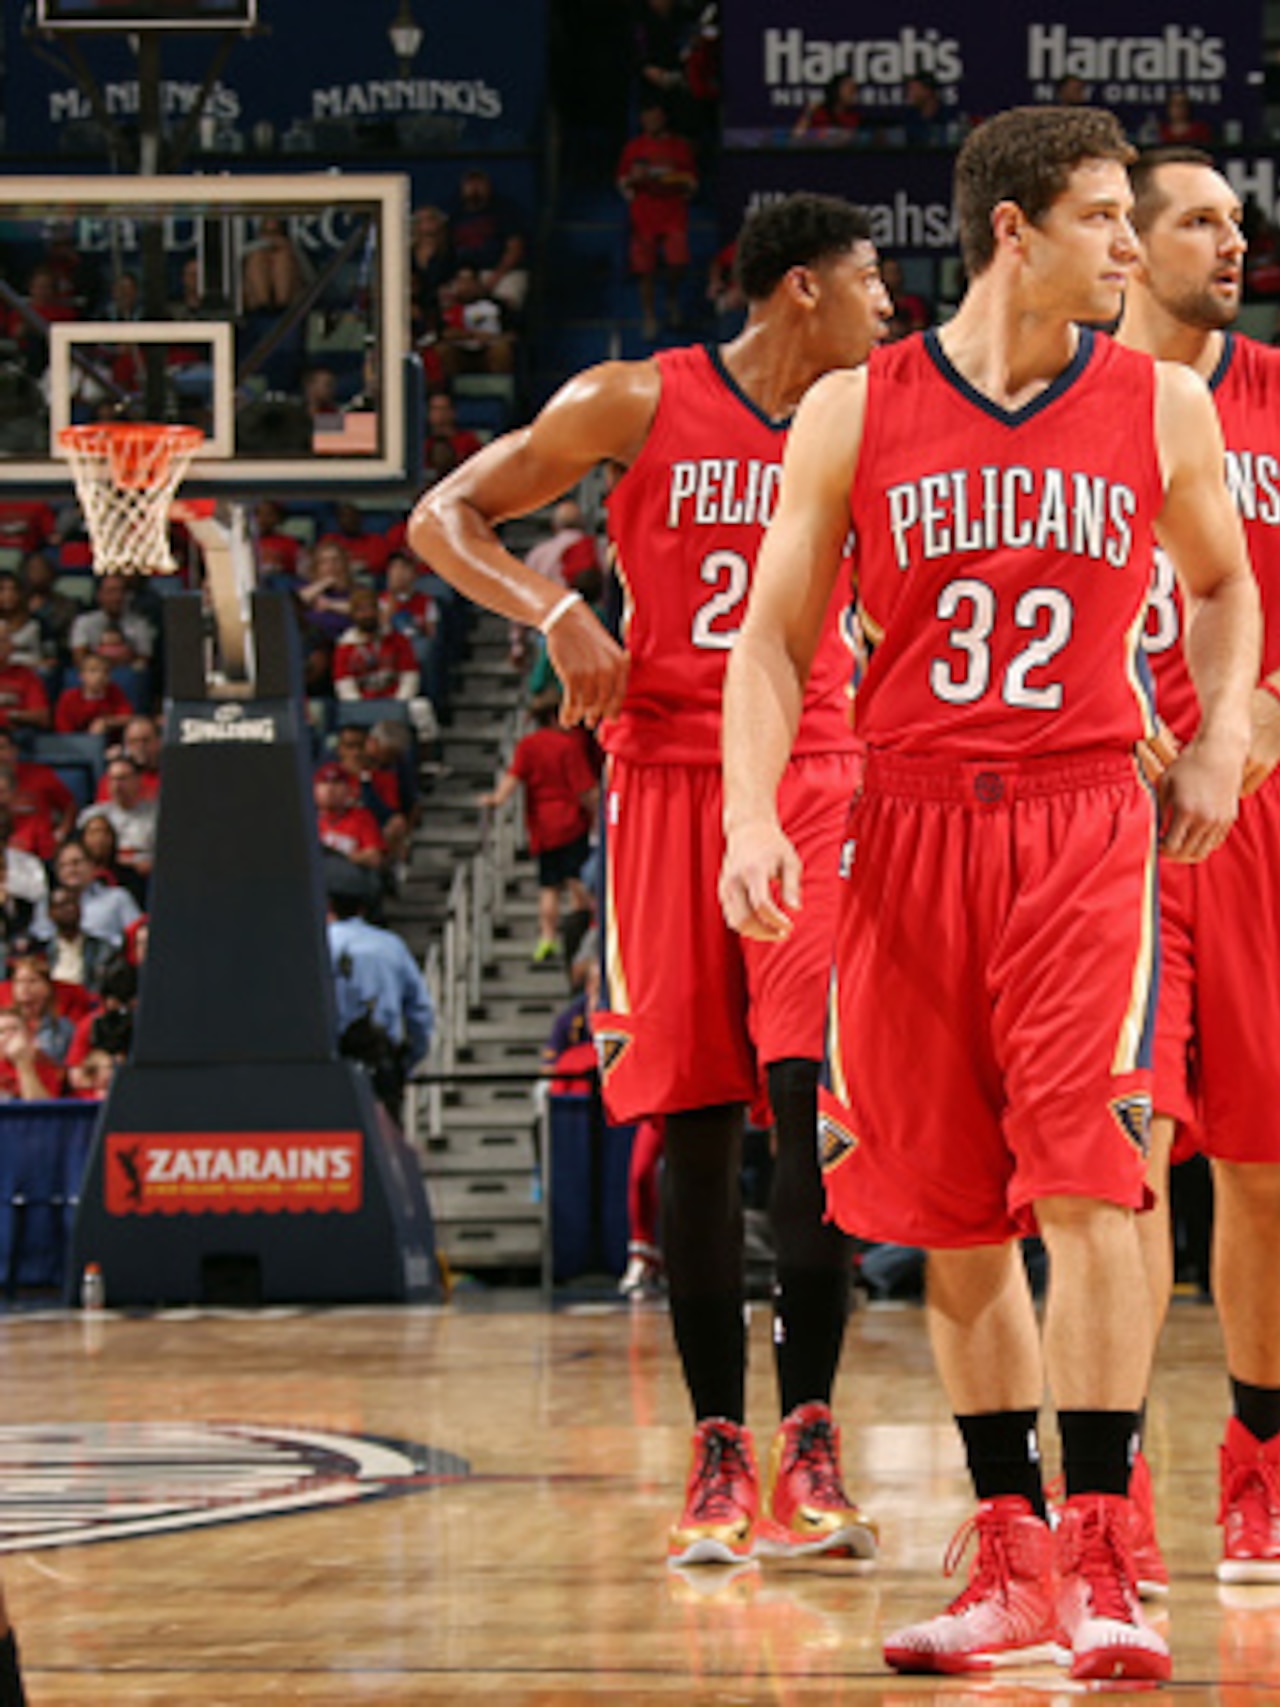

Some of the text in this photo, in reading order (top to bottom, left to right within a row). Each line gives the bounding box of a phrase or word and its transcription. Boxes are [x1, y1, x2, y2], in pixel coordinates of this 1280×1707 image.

[765, 26, 964, 86] Harrah's
[1028, 23, 1227, 81] Harrah's
[311, 79, 503, 119] MANNING'S
[885, 465, 1137, 571] PELICANS
[929, 576, 1075, 711] 32
